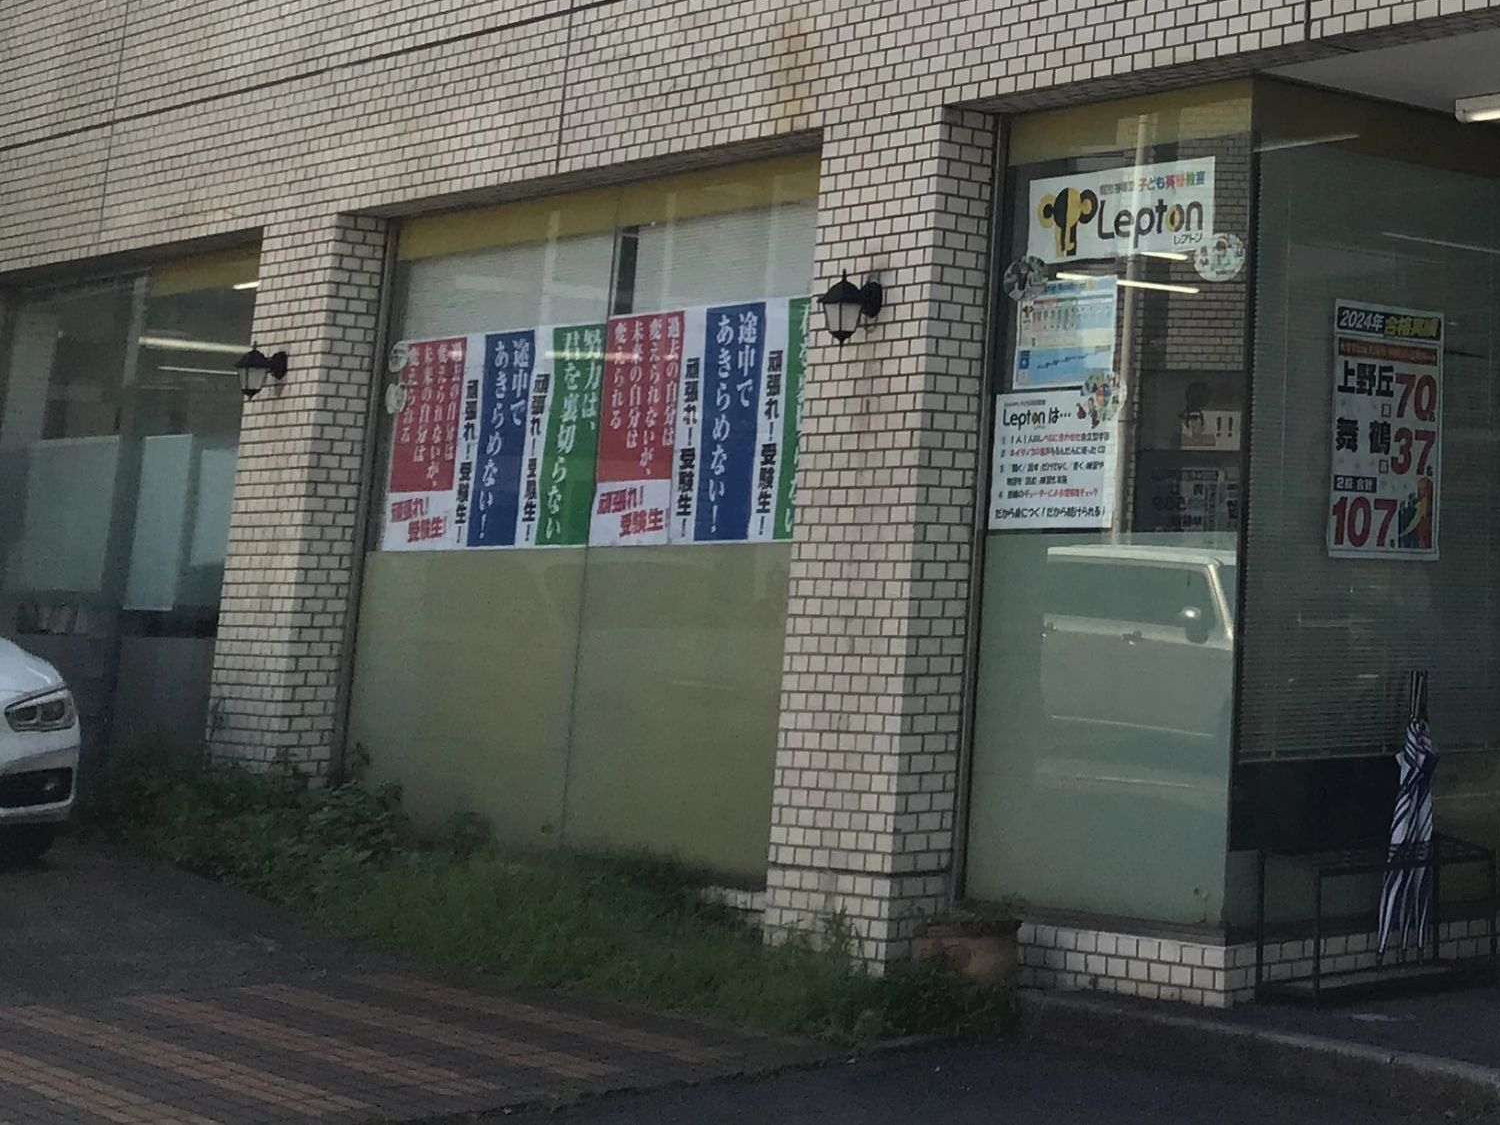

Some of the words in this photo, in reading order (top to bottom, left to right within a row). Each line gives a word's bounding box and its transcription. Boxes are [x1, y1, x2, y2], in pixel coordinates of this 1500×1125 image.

[1098, 199, 1203, 249] Lepton
[510, 338, 532, 427] 途中で
[736, 310, 759, 408] 途中で
[1002, 409, 1046, 430] Lepton
[1338, 360, 1394, 398] 上野丘
[1395, 373, 1437, 421] 70
[546, 330, 581, 539] 君を裏切らない
[708, 314, 736, 533] あきらめない！
[1336, 417, 1391, 455] 舞鶴
[1391, 427, 1436, 475] 37
[1332, 496, 1398, 548] 107
